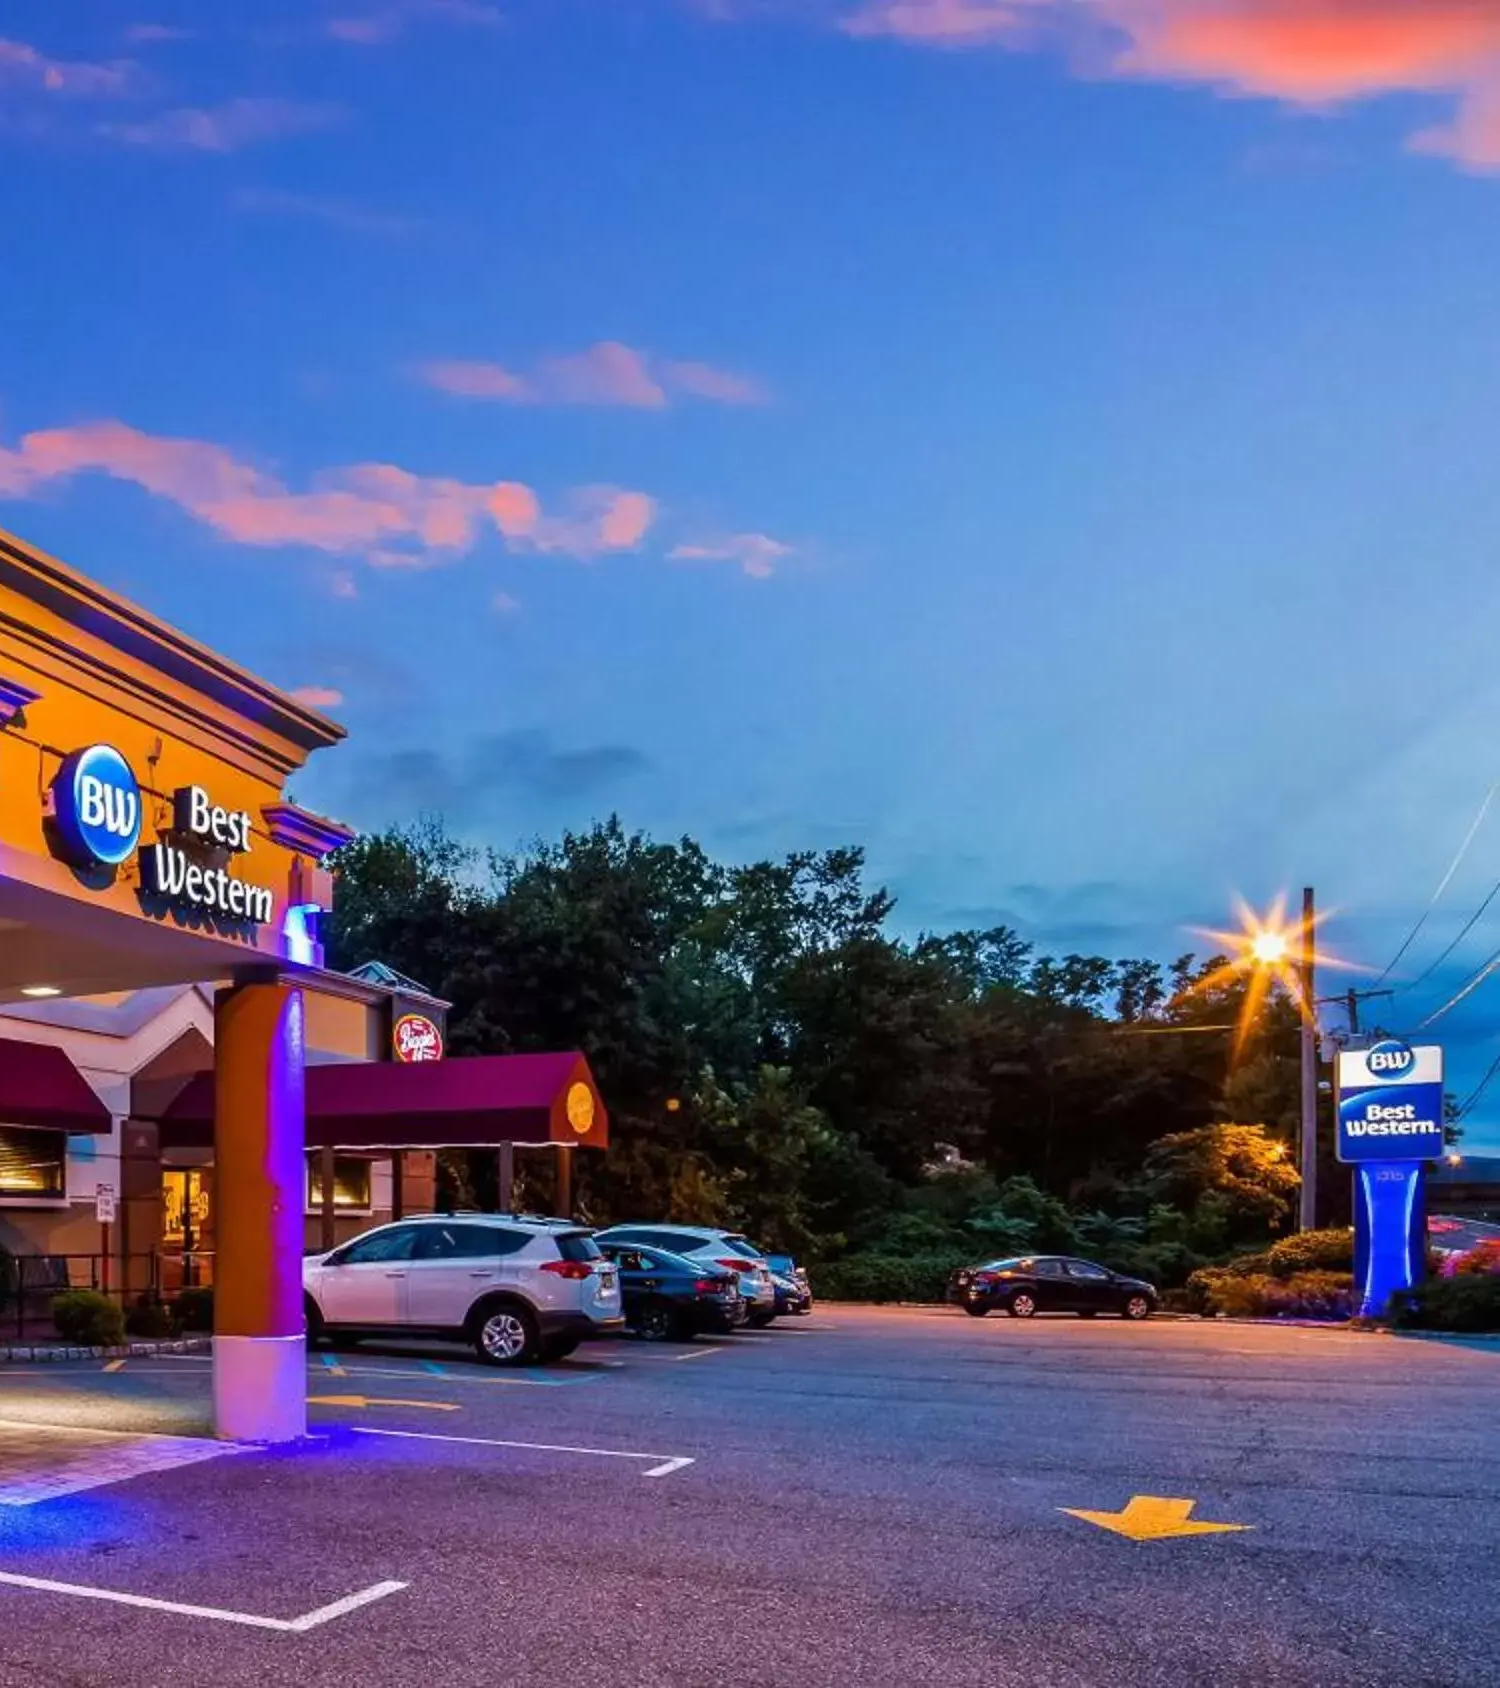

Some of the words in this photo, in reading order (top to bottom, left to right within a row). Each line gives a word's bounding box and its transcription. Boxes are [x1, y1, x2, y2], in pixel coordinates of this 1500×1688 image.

[80, 774, 136, 837] BW
[190, 784, 252, 852] Best
[155, 843, 273, 924] Western
[1371, 1051, 1411, 1071] BW
[1367, 1104, 1415, 1120] Best
